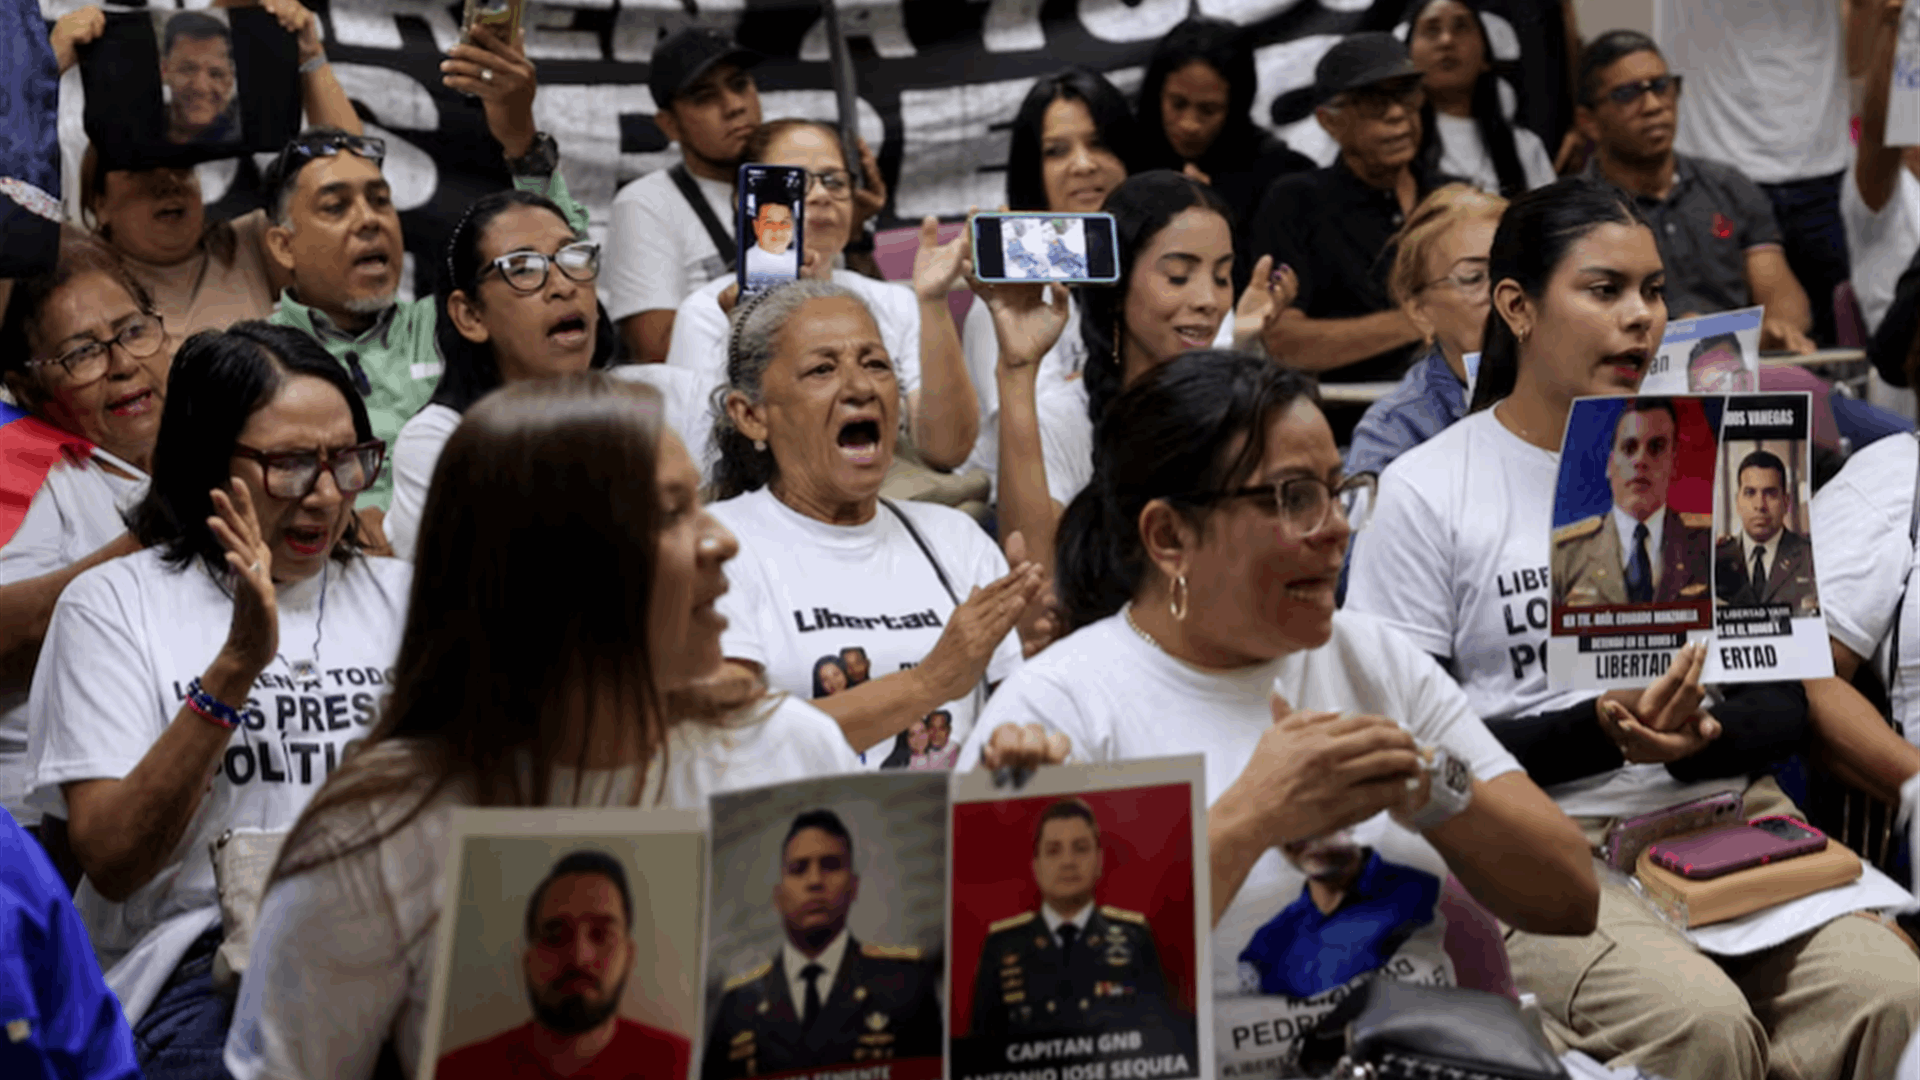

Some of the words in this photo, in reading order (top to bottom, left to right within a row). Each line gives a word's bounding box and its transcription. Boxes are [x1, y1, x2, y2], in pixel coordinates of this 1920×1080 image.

[1747, 408, 1794, 426] VANEGAS
[793, 606, 944, 634] Libertad
[1097, 1030, 1142, 1053] GNB
[1110, 1054, 1189, 1079] SEQUEA
